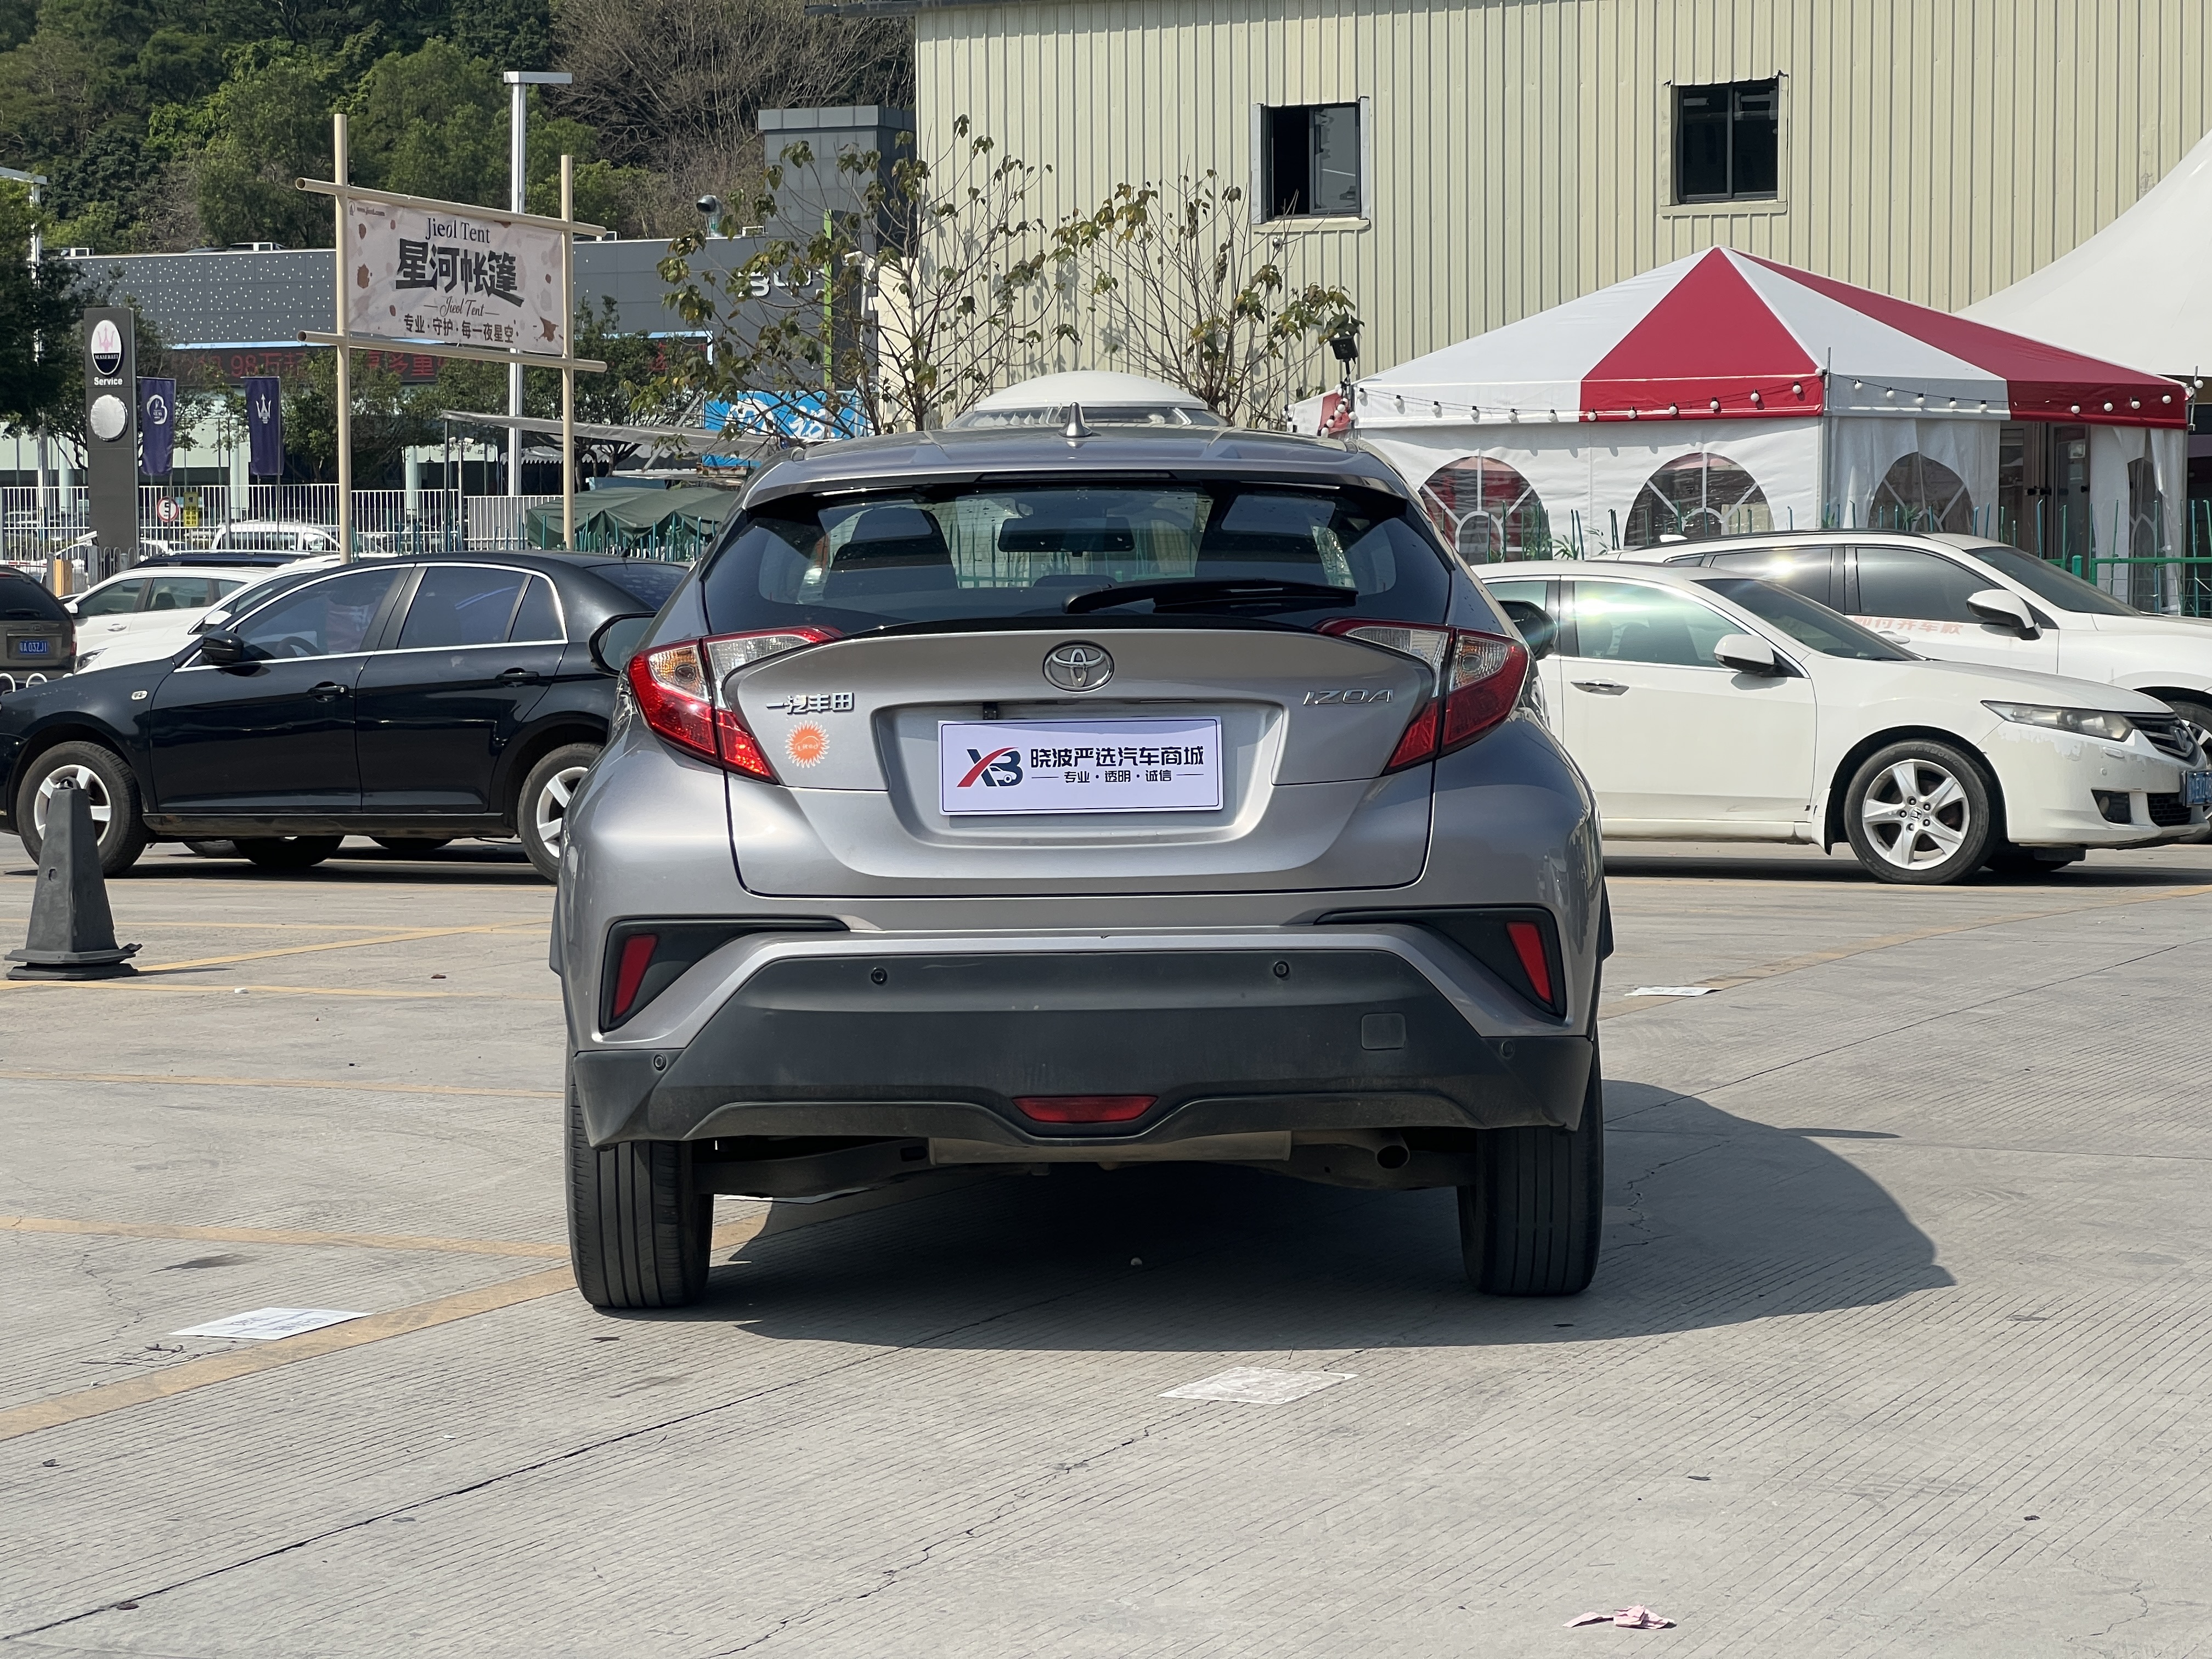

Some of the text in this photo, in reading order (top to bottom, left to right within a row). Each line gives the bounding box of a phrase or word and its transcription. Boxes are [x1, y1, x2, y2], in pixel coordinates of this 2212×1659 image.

[425, 218, 491, 244] Jieol Tent
[396, 238, 525, 308] 星河帐篷
[465, 300, 485, 317] Tent
[94, 377, 123, 385] Service
[766, 692, 854, 715] 一汽丰田
[1303, 689, 1394, 706] IZOA
[1030, 746, 1204, 768] 晓波严选汽车商城
